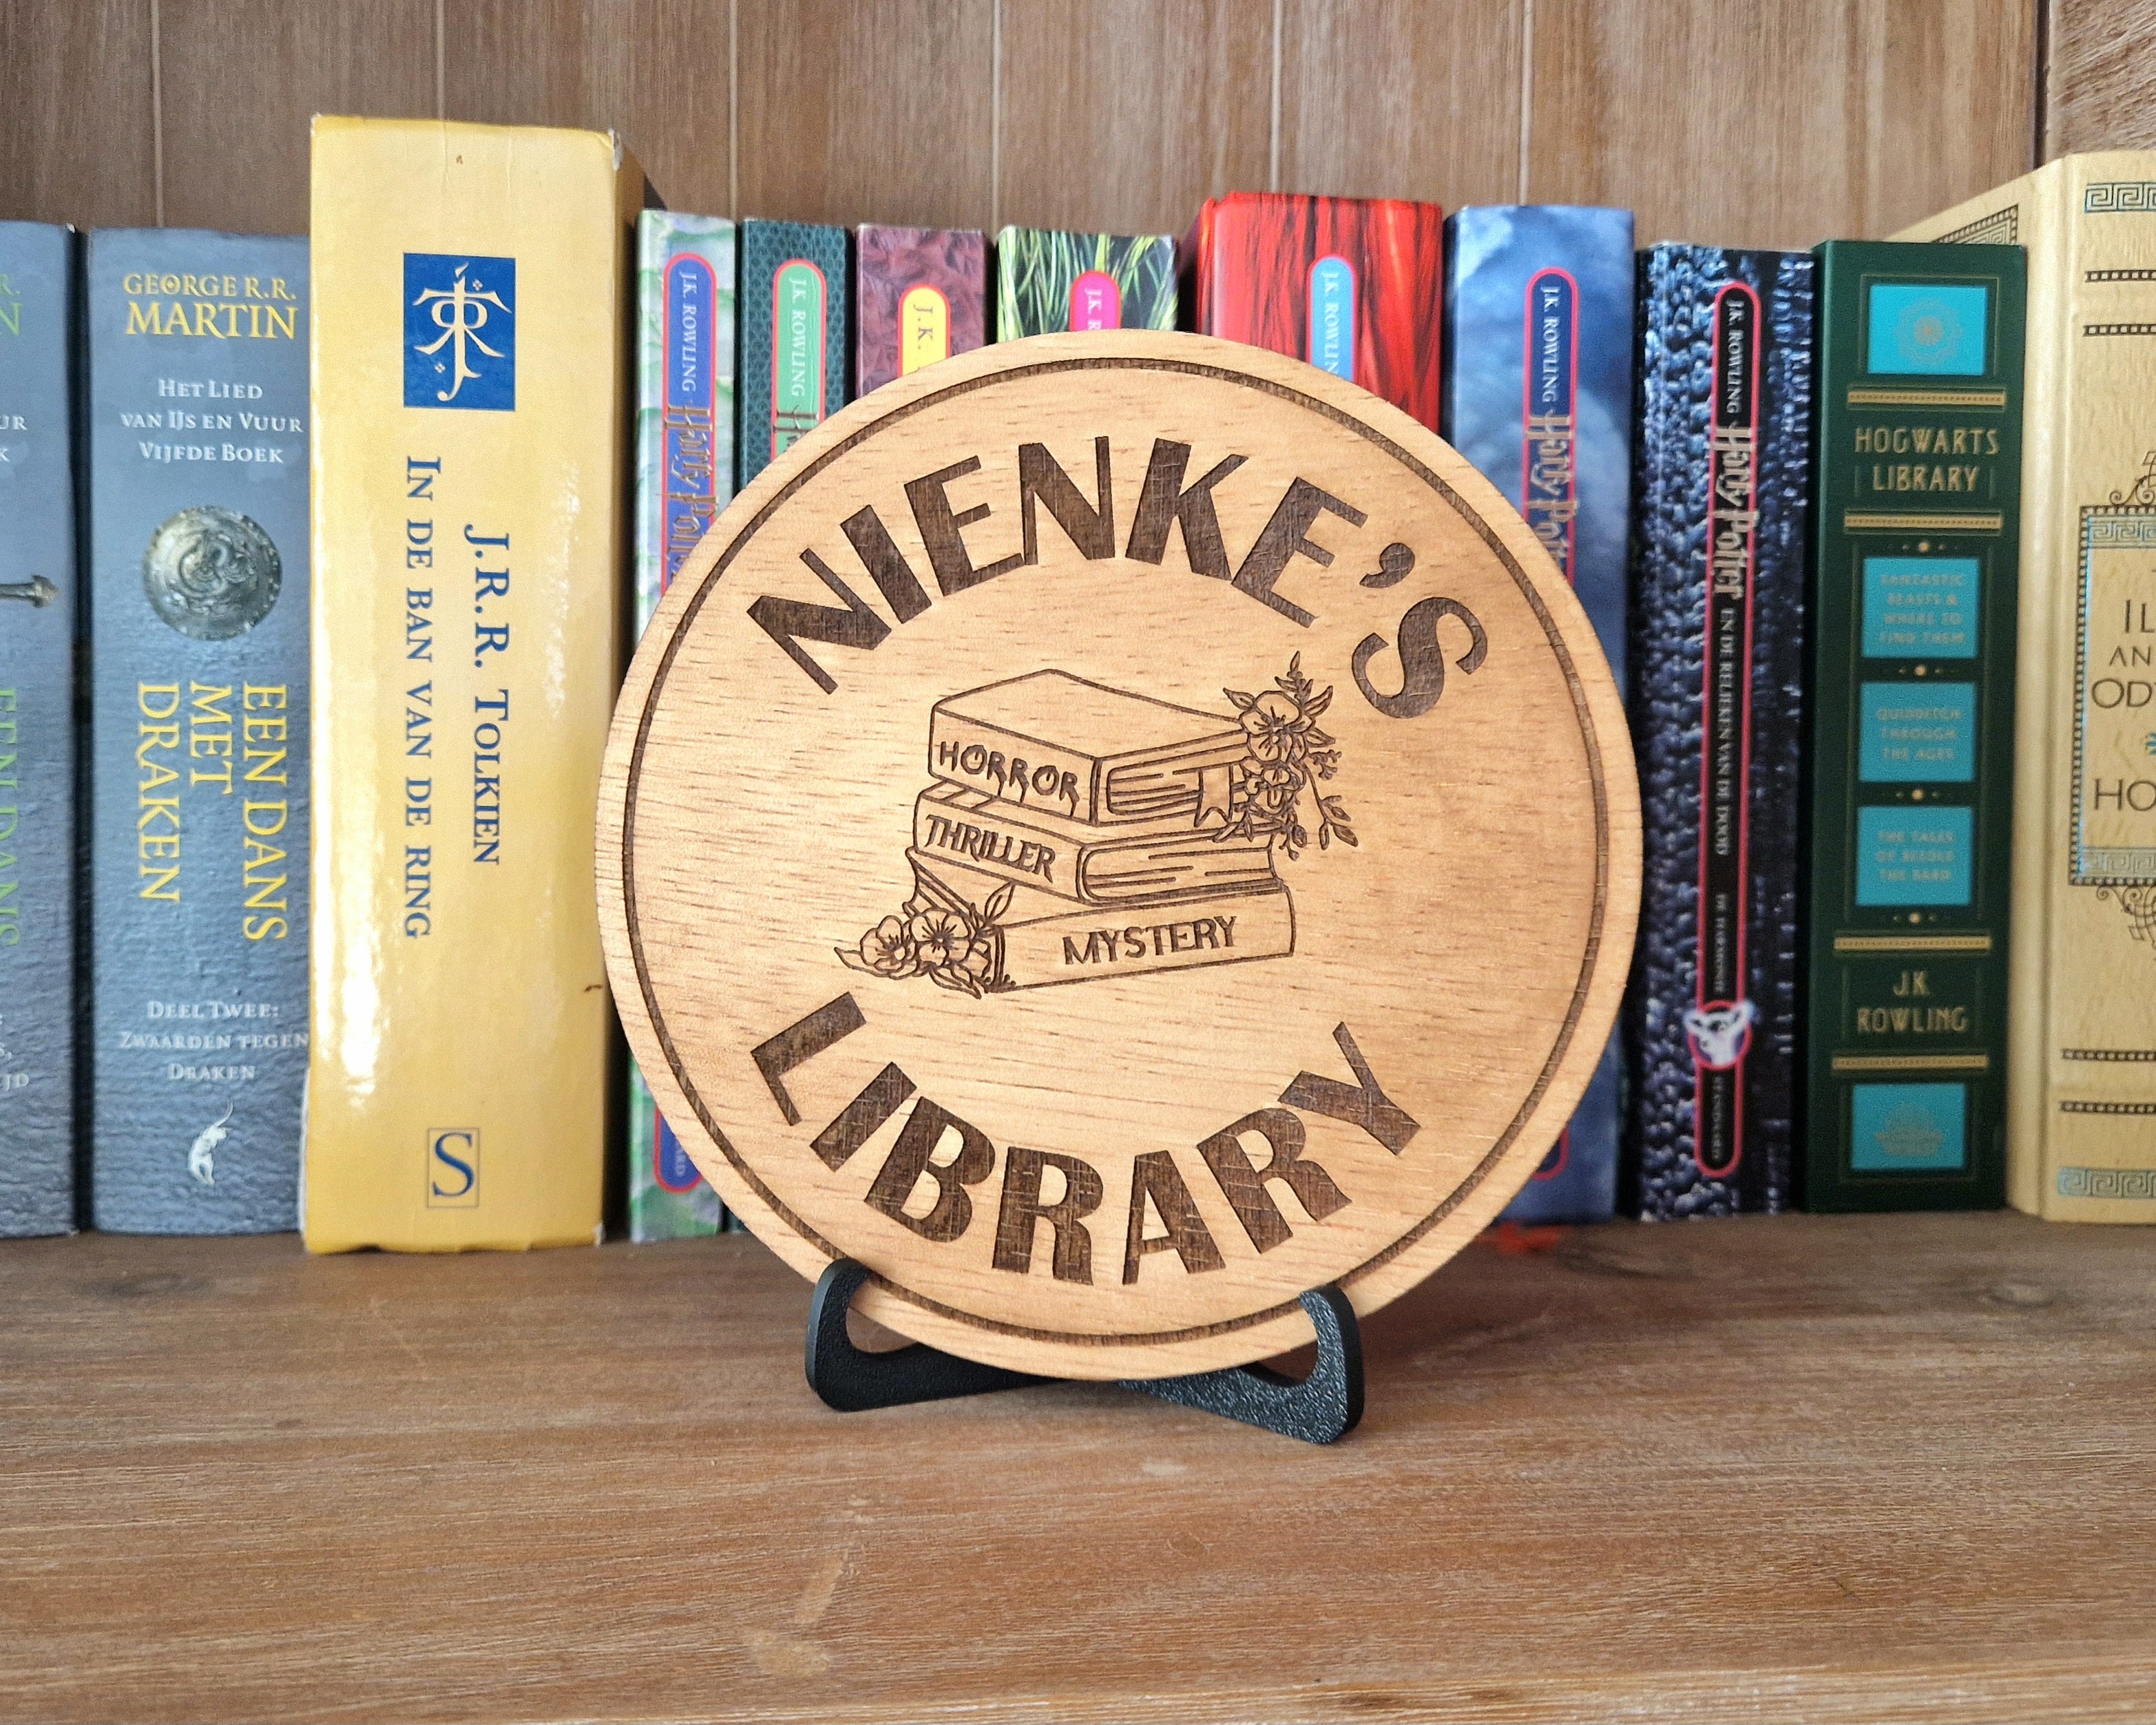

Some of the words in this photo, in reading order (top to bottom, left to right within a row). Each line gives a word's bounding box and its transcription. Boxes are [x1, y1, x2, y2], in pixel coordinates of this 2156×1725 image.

[123, 273, 238, 297] GEORGE
[244, 276, 297, 300] R.R.
[680, 271, 697, 298] J.K.
[789, 278, 806, 303] J.K.
[1085, 288, 1103, 315] J.K.
[1540, 285, 1560, 313] J.K.
[125, 301, 300, 339] MARTIN
[914, 304, 934, 350] J.K.
[1726, 300, 1745, 326] J.K.
[682, 304, 697, 392] ROWLING
[792, 309, 806, 397] ROWLING
[1325, 302, 1340, 375] ROWLIN
[1542, 316, 1560, 403] ROWLING
[158, 378, 205, 398] HET
[208, 379, 264, 399] LIED
[1727, 330, 1745, 413] ROWLING
[121, 413, 163, 429] VAN
[168, 410, 197, 431] IJS
[202, 415, 232, 430] EN
[238, 412, 304, 433] VUUR
[664, 401, 713, 489] Harry
[1854, 426, 2000, 454] HOGWARTS
[138, 441, 217, 464] VIJFDE
[221, 443, 284, 464] BOEK
[1525, 412, 1573, 496] Harry
[1710, 423, 1757, 507] Harry
[1873, 464, 1980, 491] LIBRARY
[406, 455, 441, 501] IN
[406, 519, 433, 569] DE
[1525, 499, 1579, 559] Pott
[747, 435, 1489, 719] NIENKE'S
[1710, 509, 1759, 600] Potter
[464, 524, 510, 668] J.R.R.
[1721, 607, 1735, 631] EN
[406, 587, 433, 662] BAN
[1720, 634, 1734, 654] DE
[2109, 645, 2151, 667] AN
[406, 680, 432, 758] VAN
[1718, 662, 1735, 740] RELIEKEN
[189, 680, 233, 795] MET
[244, 681, 287, 787] EEN
[1717, 742, 1733, 775] VAN
[136, 682, 180, 903] DRAKEN
[405, 777, 432, 826] DE
[474, 689, 510, 866] TOLKIEN
[939, 741, 1080, 817] HORROR
[1717, 780, 1731, 799] DE
[925, 813, 1056, 883] THRILLER
[1716, 805, 1730, 855] DOOD
[244, 798, 289, 941] DANS
[404, 845, 432, 939] RING
[1063, 916, 1237, 965] MYSTERY
[147, 1001, 205, 1020] DEEL
[209, 1001, 279, 1019] TWEE:
[1858, 1007, 1969, 1032] ROWLING
[119, 1032, 231, 1049] ZWAARDEN
[239, 1033, 309, 1049] TEGEN
[168, 1063, 256, 1081] DRAKEN
[750, 990, 1421, 1286] LIBRARY
[432, 1131, 474, 1198] S
